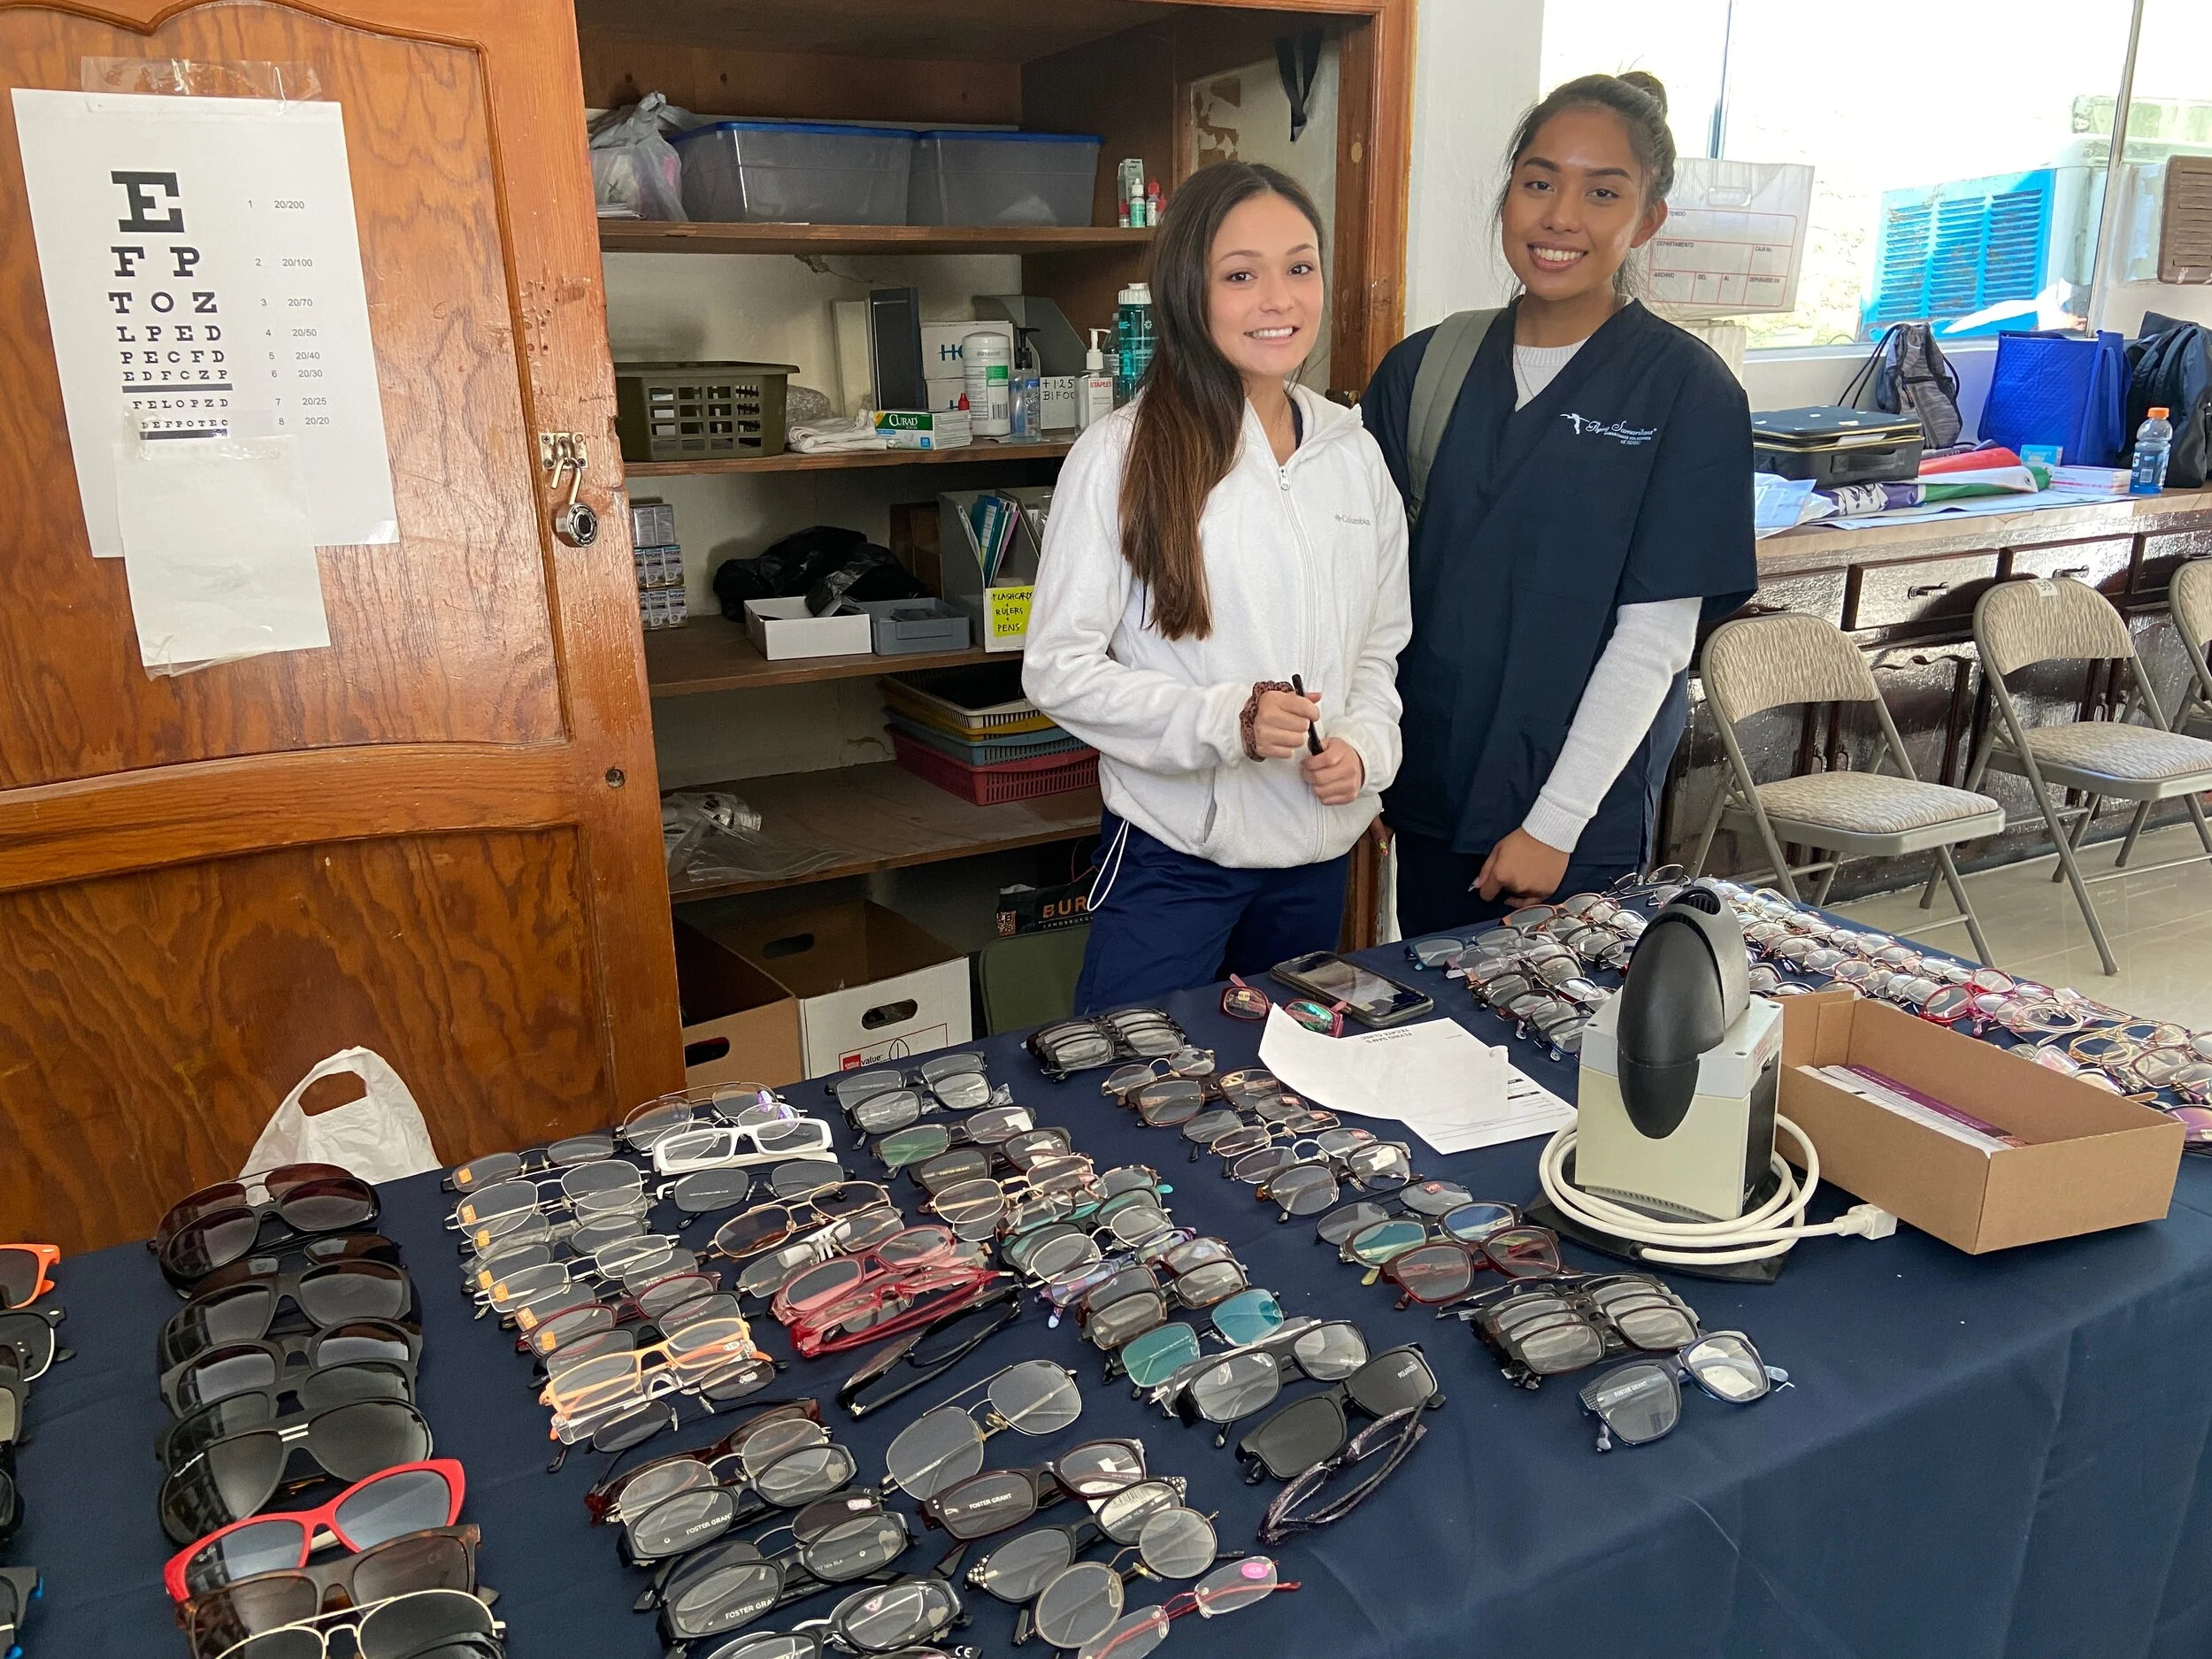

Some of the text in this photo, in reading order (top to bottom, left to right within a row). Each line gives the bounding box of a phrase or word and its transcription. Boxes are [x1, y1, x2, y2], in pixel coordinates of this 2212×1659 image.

[111, 171, 185, 233] E
[247, 200, 305, 210] 1 20/200
[282, 258, 313, 267] 20/100
[261, 298, 313, 307] 3 20/70
[265, 328, 318, 337] 4 20/50
[269, 351, 320, 360] 5 20/40
[272, 370, 323, 379] 6 20/30
[275, 397, 326, 406] 7 20/25
[305, 417, 330, 426] 20/20
[888, 413, 918, 427] CURAD
[995, 607, 1024, 616] RULERS
[997, 623, 1020, 633] PENS
[861, 1056, 881, 1065] value
[969, 1494, 1012, 1509] FOSTER GRANT
[686, 1521, 710, 1535] FOSTER
[725, 1605, 754, 1619] FOSTER
